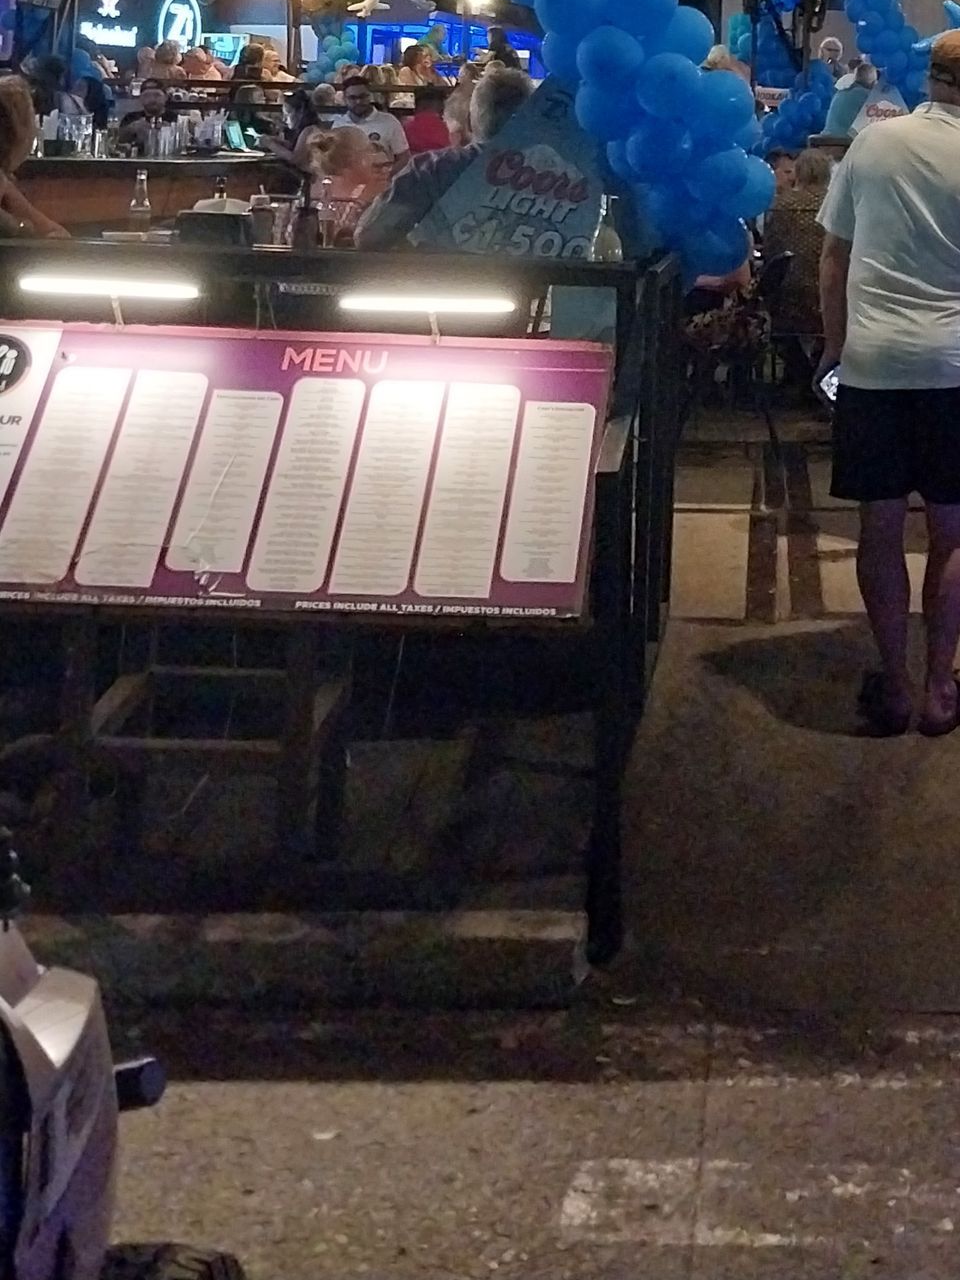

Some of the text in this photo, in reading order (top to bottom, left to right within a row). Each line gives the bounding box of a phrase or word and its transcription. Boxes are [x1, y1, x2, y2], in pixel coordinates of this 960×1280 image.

[485, 149, 590, 204] Coors
[481, 187, 578, 224] LIGHT
[281, 345, 389, 374] MENU
[294, 600, 331, 610] PRICES
[333, 601, 378, 611] INCLUDE
[379, 603, 398, 612] ALL
[400, 604, 434, 613] TAXES
[442, 605, 500, 615] IMPUESTOS
[502, 607, 556, 617] INCLUIDOS
